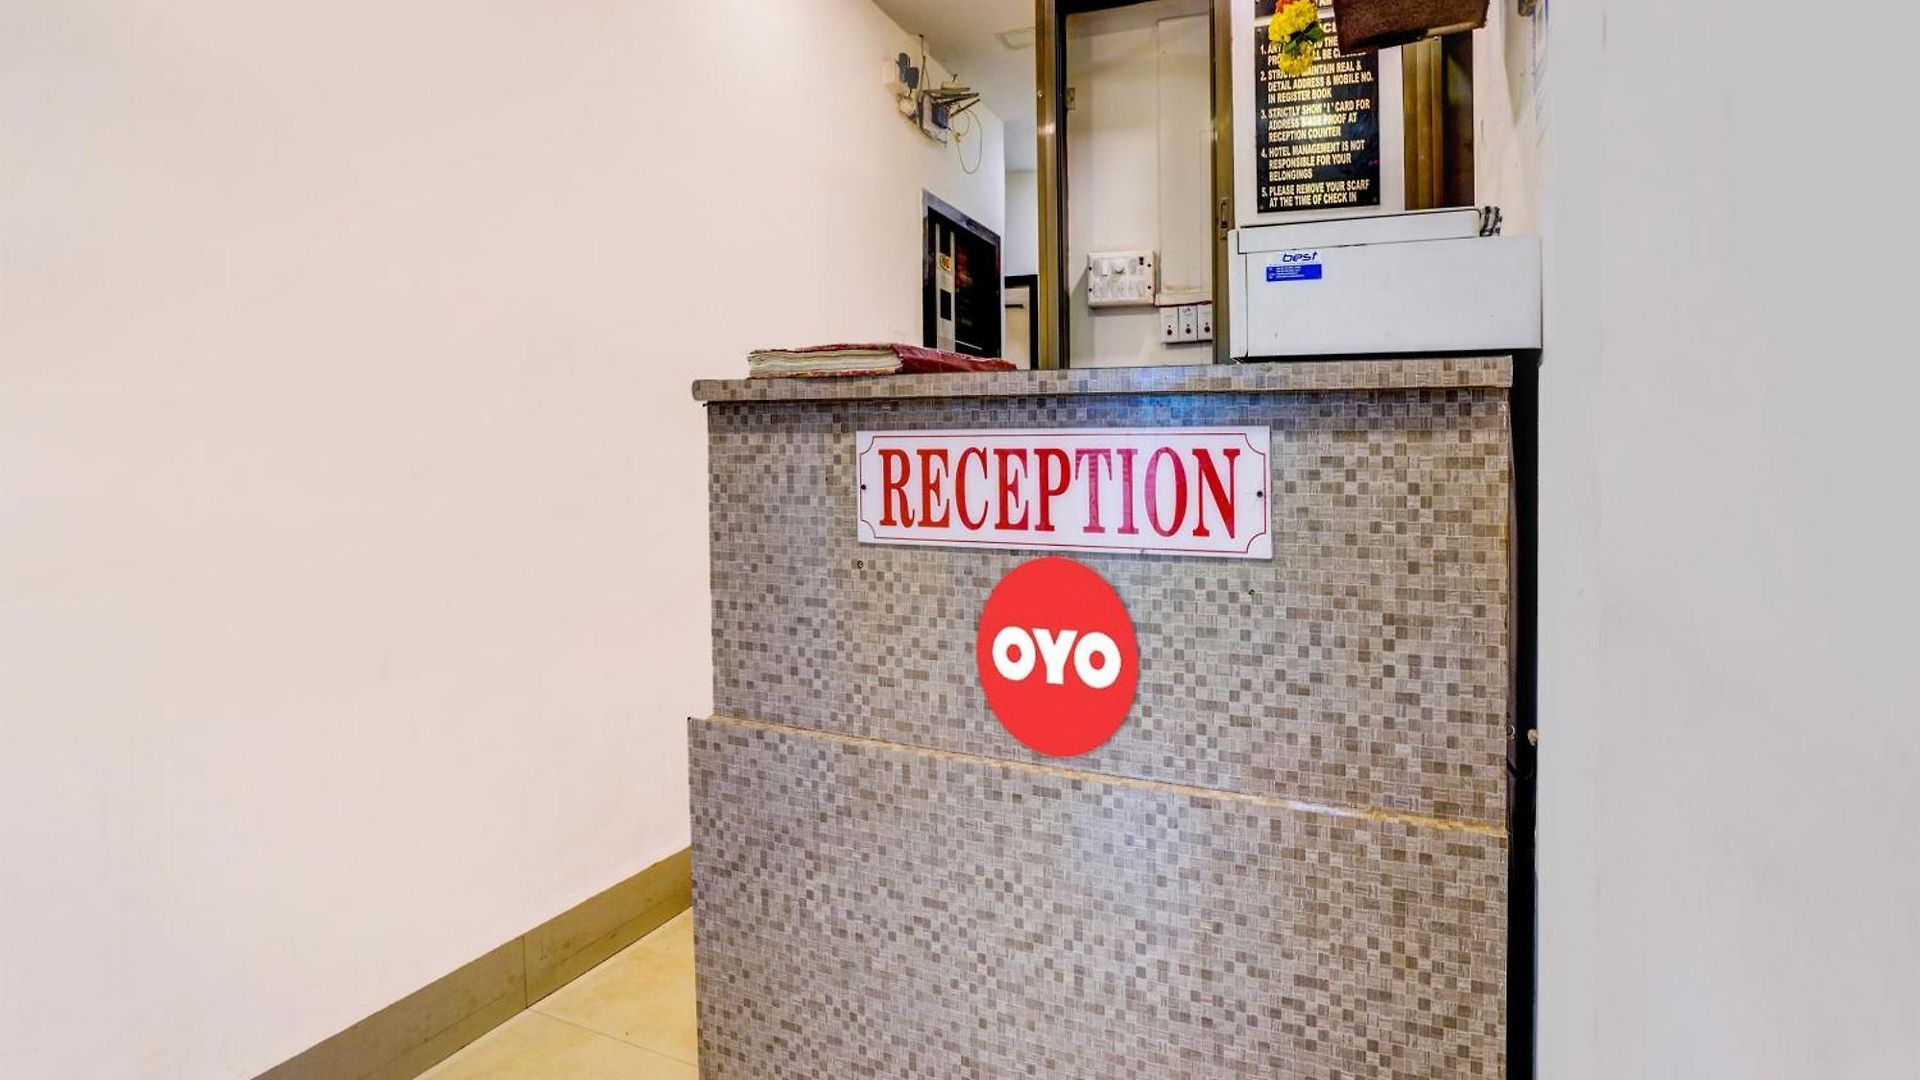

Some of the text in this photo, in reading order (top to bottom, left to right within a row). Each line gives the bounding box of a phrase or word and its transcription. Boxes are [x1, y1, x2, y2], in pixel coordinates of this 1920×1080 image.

[1260, 71, 1266, 81] 2.
[1336, 61, 1354, 72] REAL
[1356, 61, 1362, 70] &
[1268, 71, 1374, 92] DETAIL ADDRESS & MOBILE NO.
[1268, 88, 1332, 104] IN REGISTER BOOK
[1260, 109, 1266, 119] 3.
[1268, 105, 1300, 118] STRICTLY
[1302, 103, 1322, 115] SHOW
[1334, 101, 1354, 112] CARD
[1356, 98, 1370, 110] FOR
[1268, 117, 1300, 130] ADDRESS
[1348, 112, 1358, 123] AT
[1268, 126, 1341, 143] RECEPTION COUNTER
[1261, 140, 1365, 158] 4. HOTEL MANAGEMENT IS NOT
[1269, 153, 1352, 170] RESPONSIBLE FOR YOUR
[1269, 168, 1312, 182] BELONGINGS
[1261, 179, 1369, 197] 5. PLEASE REMOVE YOUR SCARF
[1269, 192, 1358, 208] AT THE TIME OF CHECK IN
[1282, 251, 1318, 262] best
[878, 446, 1241, 539] RECEPTION
[992, 625, 1121, 689] OYO
